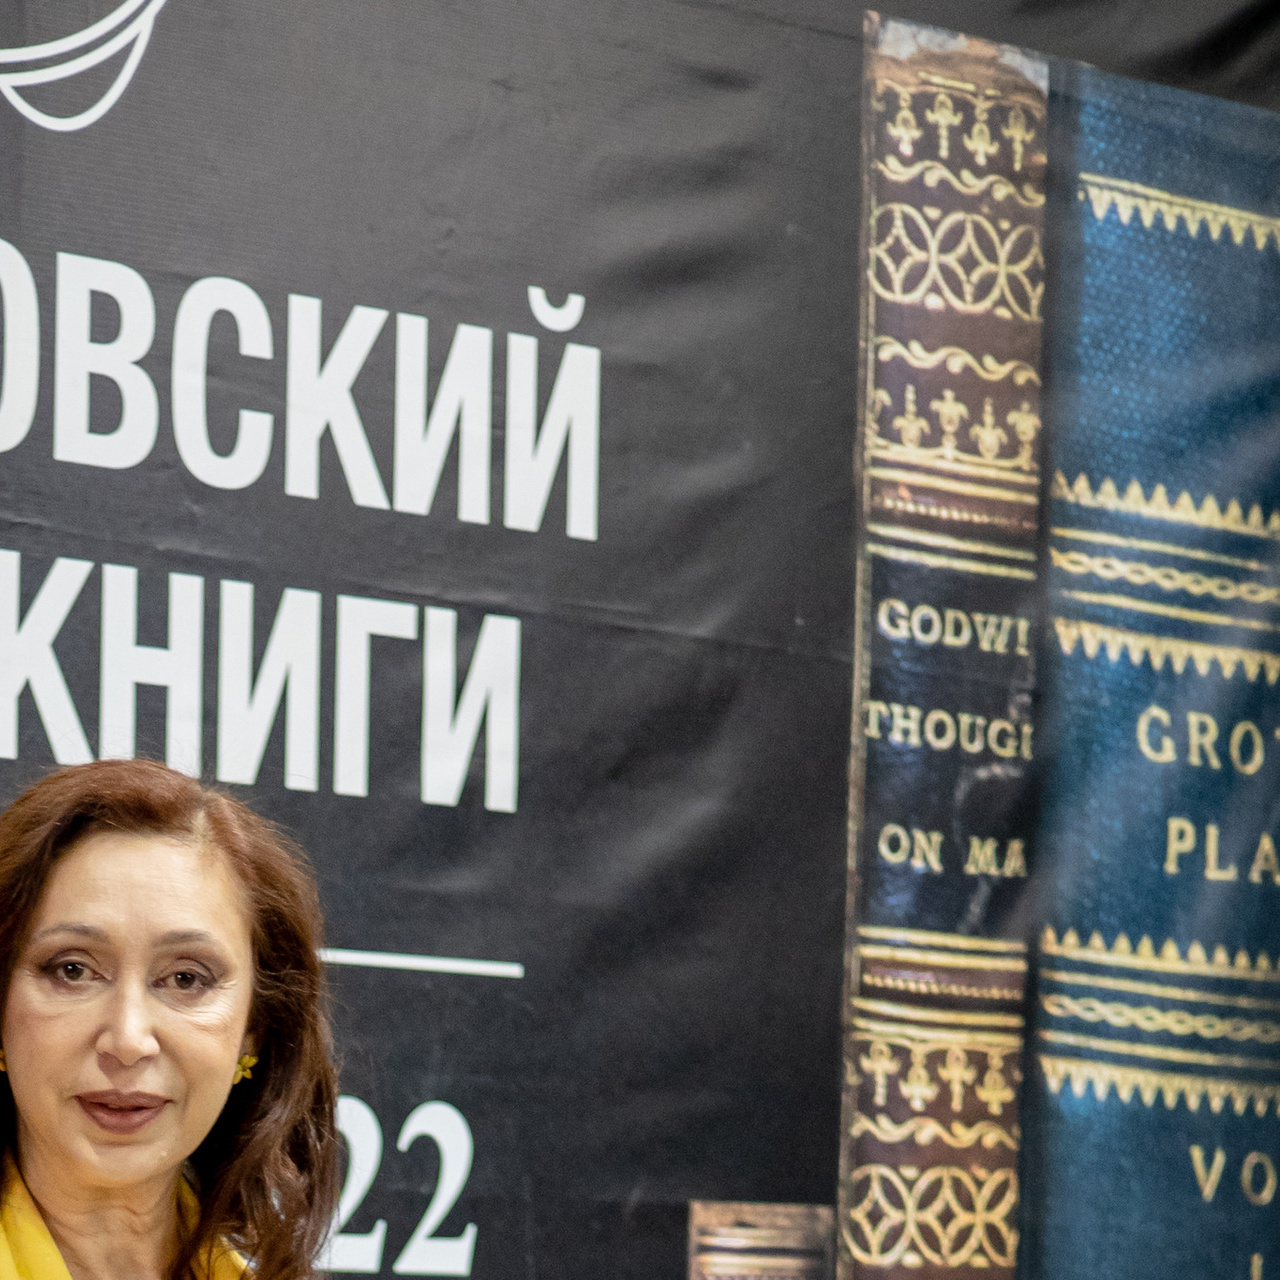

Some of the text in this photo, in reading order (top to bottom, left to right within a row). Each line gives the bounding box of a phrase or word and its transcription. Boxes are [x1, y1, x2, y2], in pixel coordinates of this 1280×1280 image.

[1135, 704, 1280, 776] GRO
[878, 823, 944, 875] ON
[310, 1094, 479, 1278] 22
